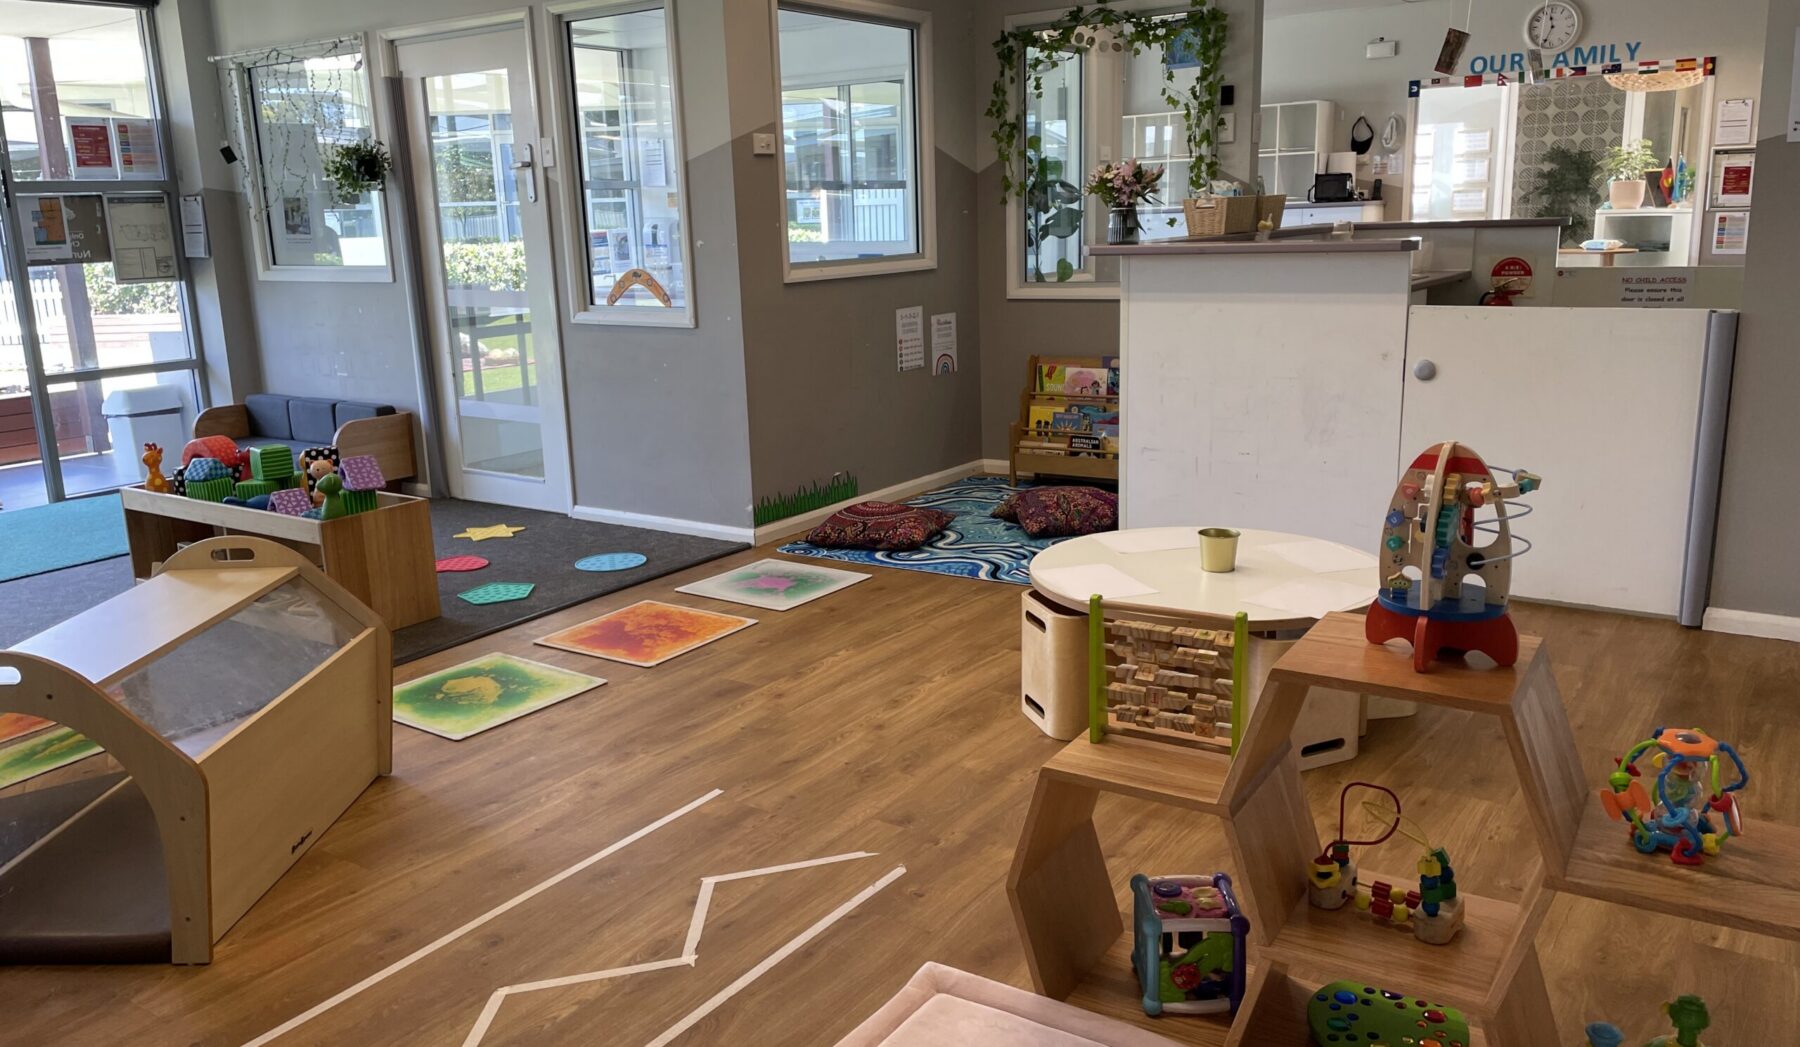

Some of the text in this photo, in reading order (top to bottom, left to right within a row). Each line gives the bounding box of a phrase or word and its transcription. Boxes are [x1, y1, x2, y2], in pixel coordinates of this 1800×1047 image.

[1470, 41, 1642, 75] OUR AMILY
[1622, 276, 1687, 284] NO CHILD ACCESS
